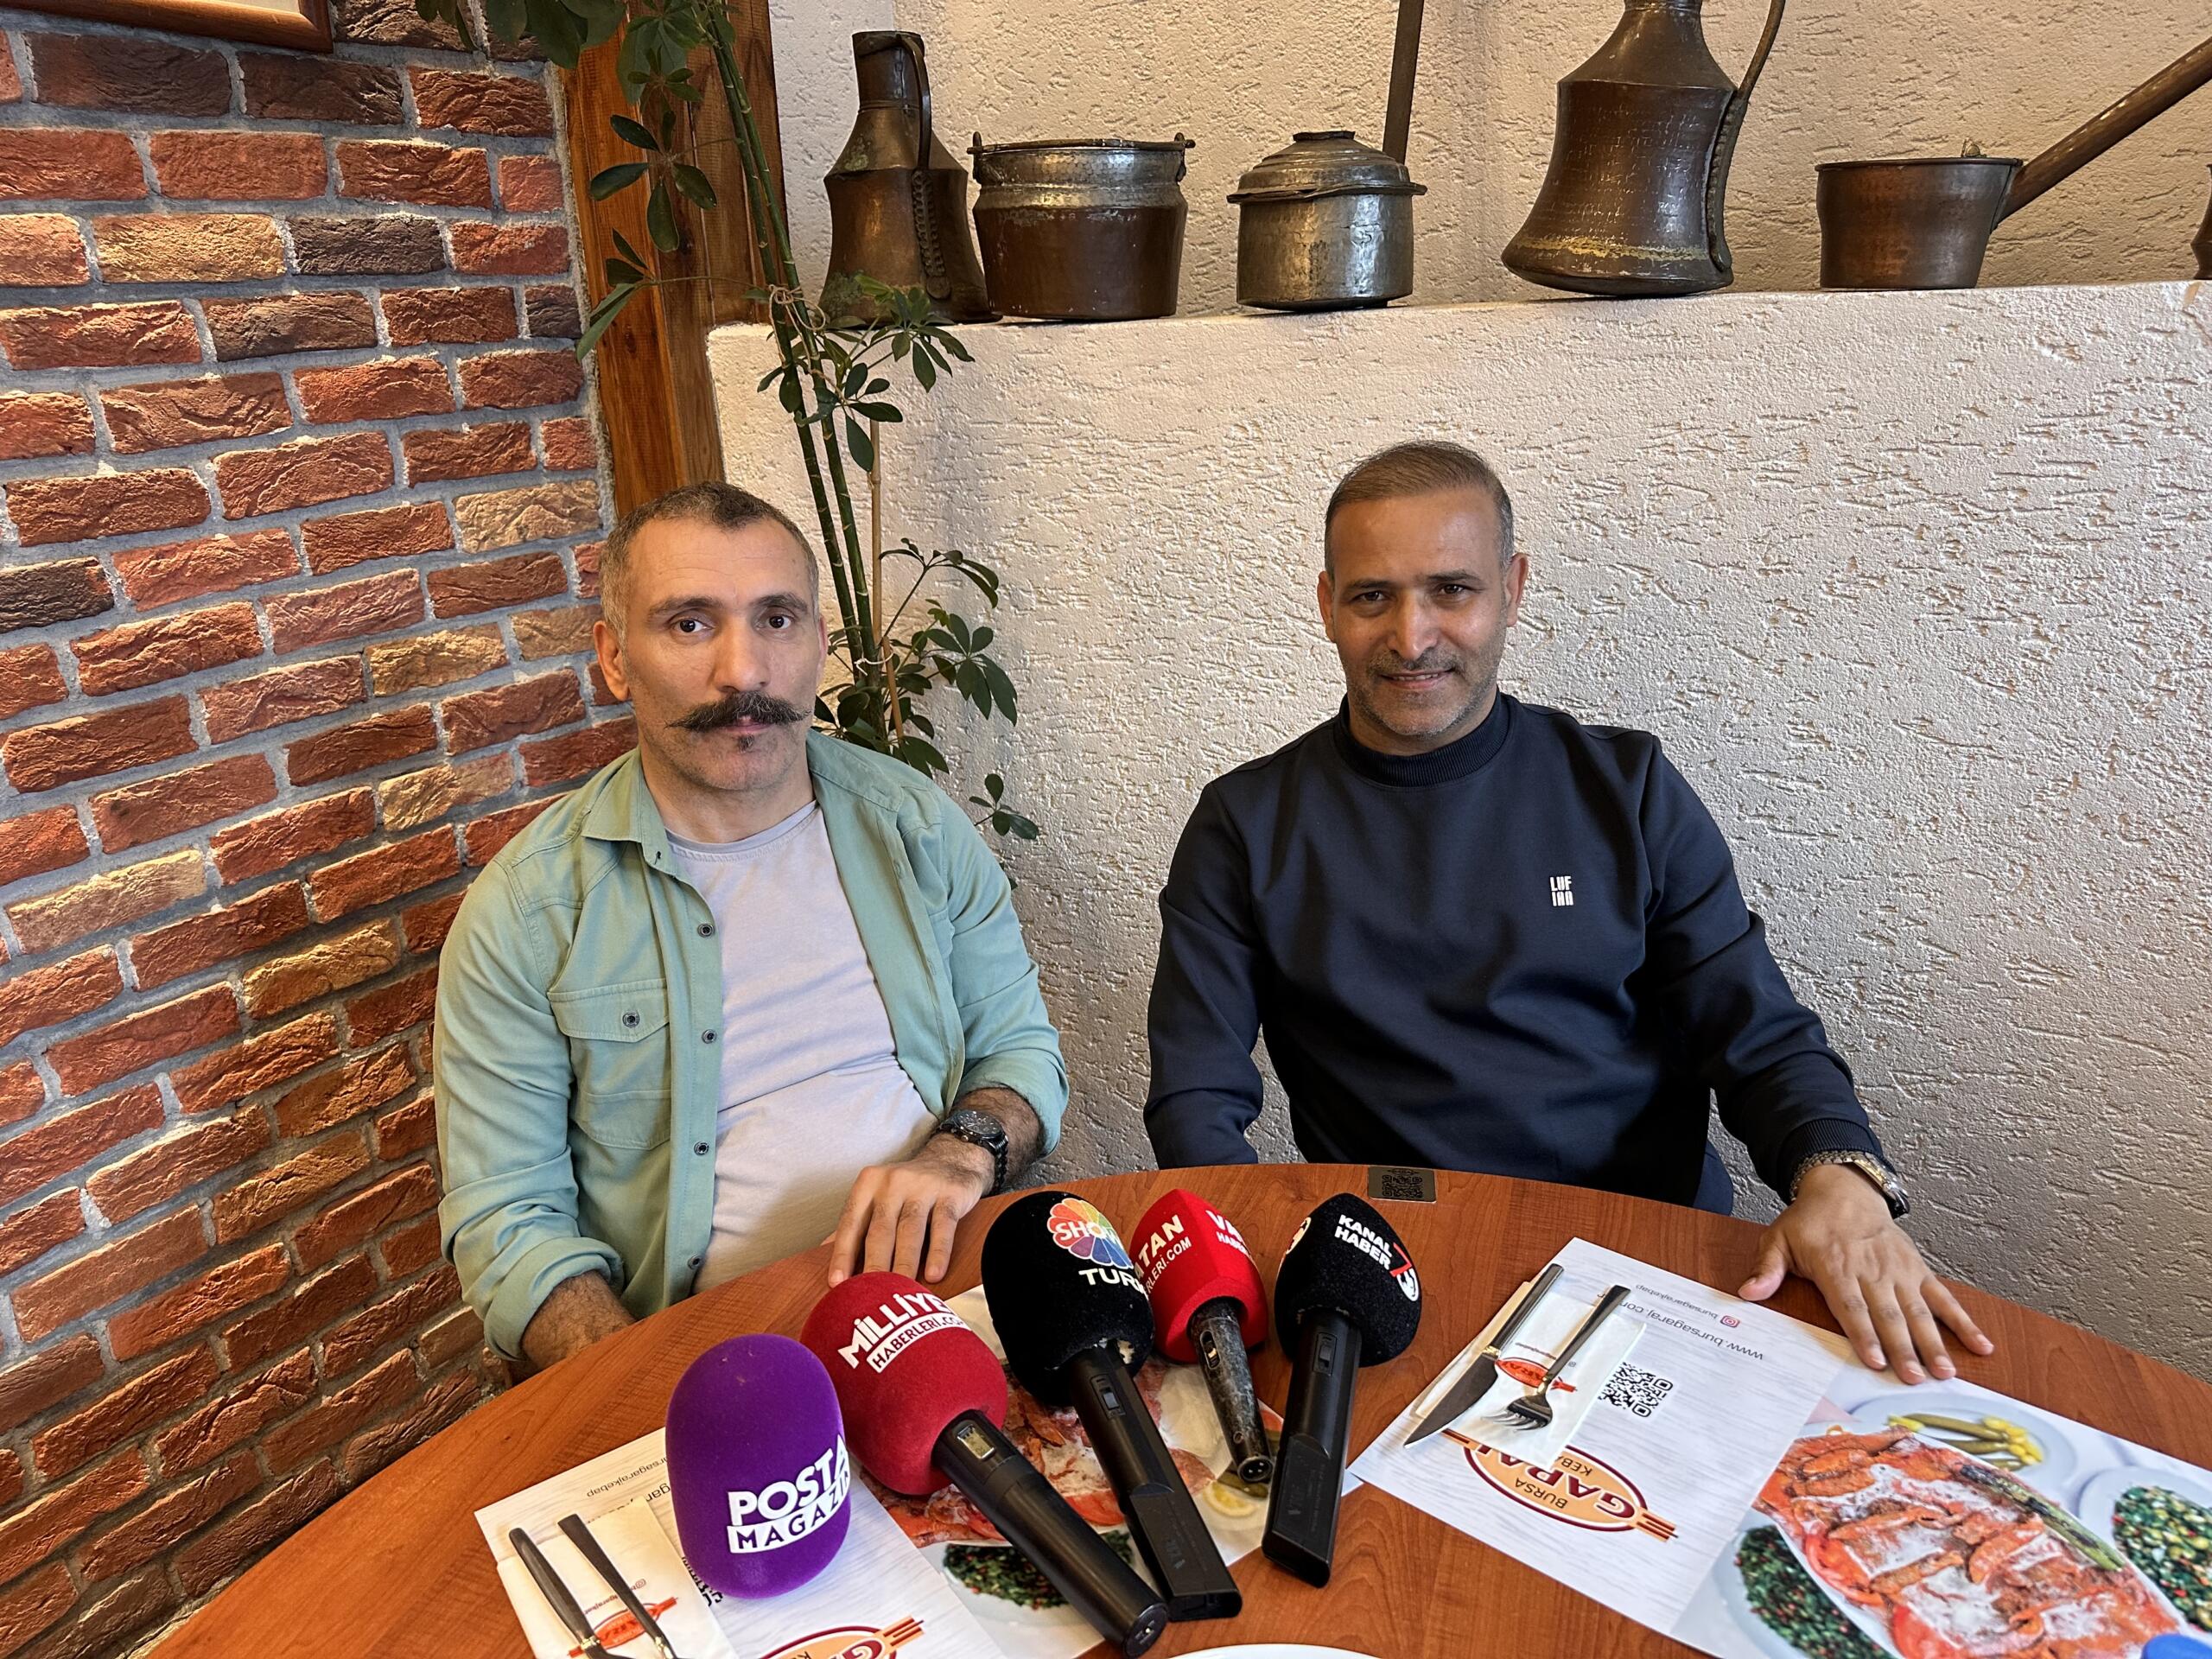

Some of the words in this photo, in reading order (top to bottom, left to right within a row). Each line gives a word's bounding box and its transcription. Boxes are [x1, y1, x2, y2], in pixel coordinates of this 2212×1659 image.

[1549, 875, 1572, 891] LUF
[1055, 1221, 1124, 1250] SHOW
[1334, 1225, 1392, 1270] HABER
[1339, 1214, 1393, 1257] KANAL
[1635, 1283, 1718, 1319] bursagarajkebap
[837, 1293, 957, 1369] MİLLİYE
[728, 1433, 851, 1526] POSTA
[1515, 1477, 1568, 1509] BURSA
